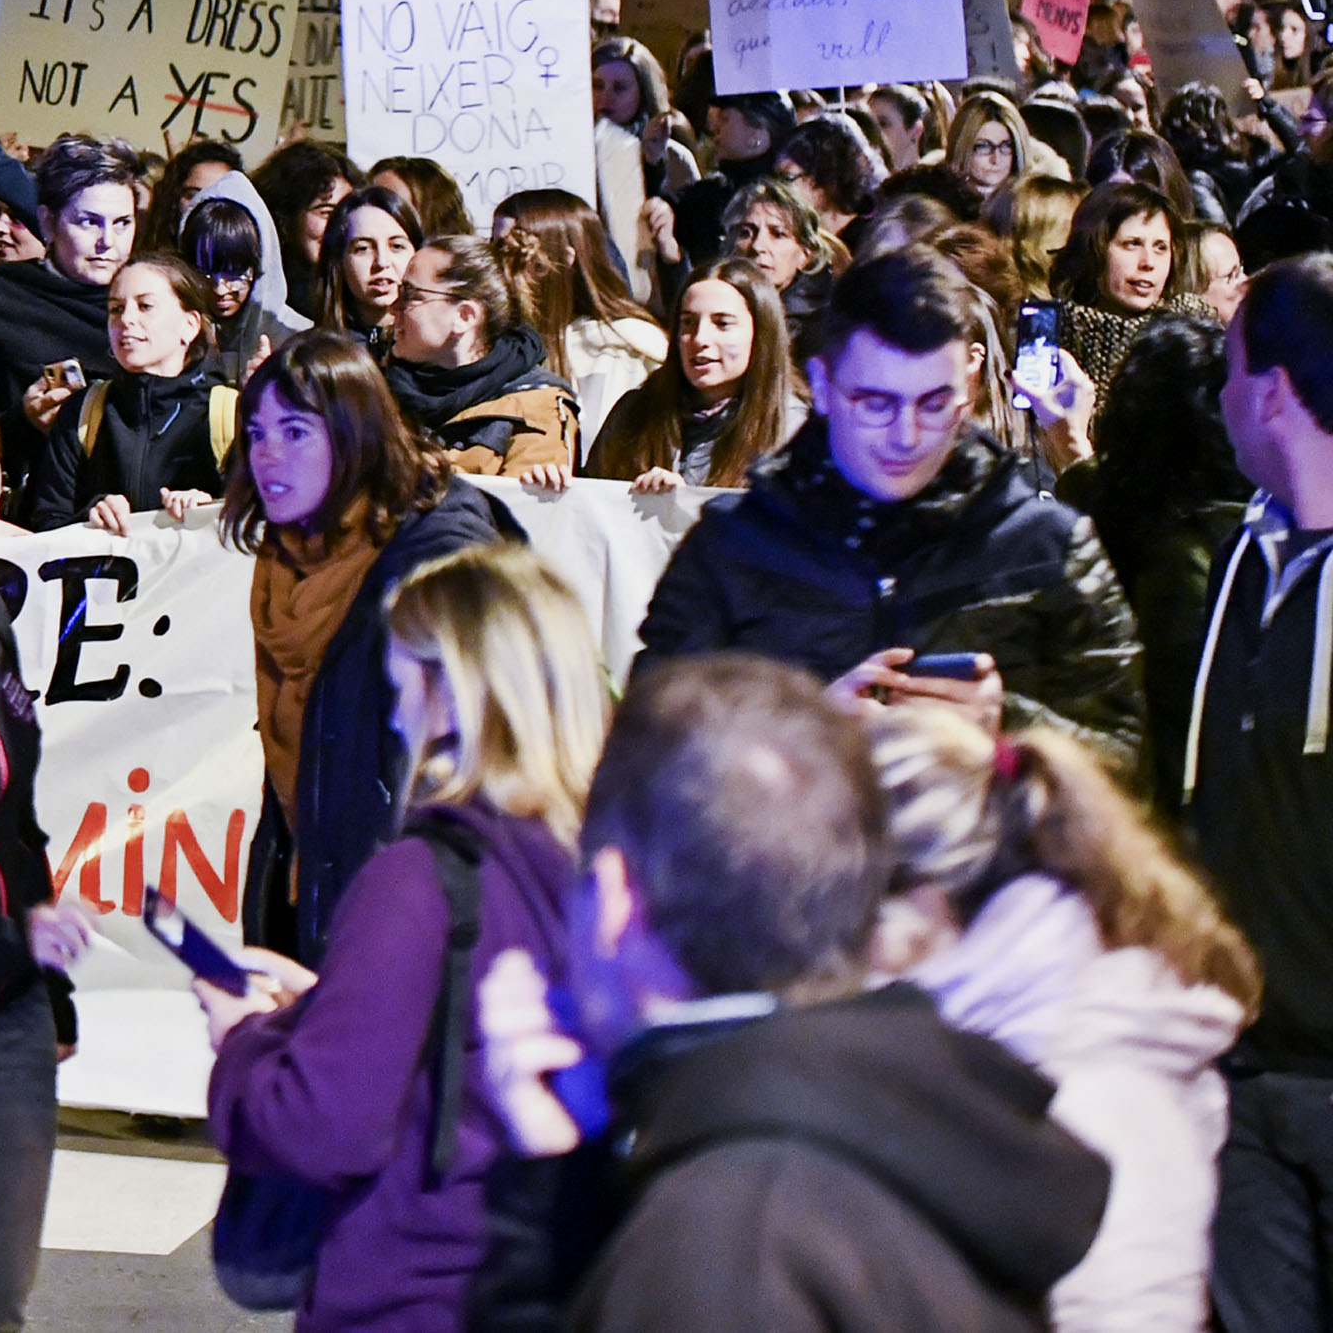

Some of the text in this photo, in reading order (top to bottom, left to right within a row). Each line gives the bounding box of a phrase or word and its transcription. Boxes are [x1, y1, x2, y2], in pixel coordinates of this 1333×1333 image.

[357, 1, 416, 54] NO
[18, 59, 89, 107] NOT
[108, 75, 139, 116] A
[161, 62, 259, 144] YES
[412, 108, 553, 155] DONA
